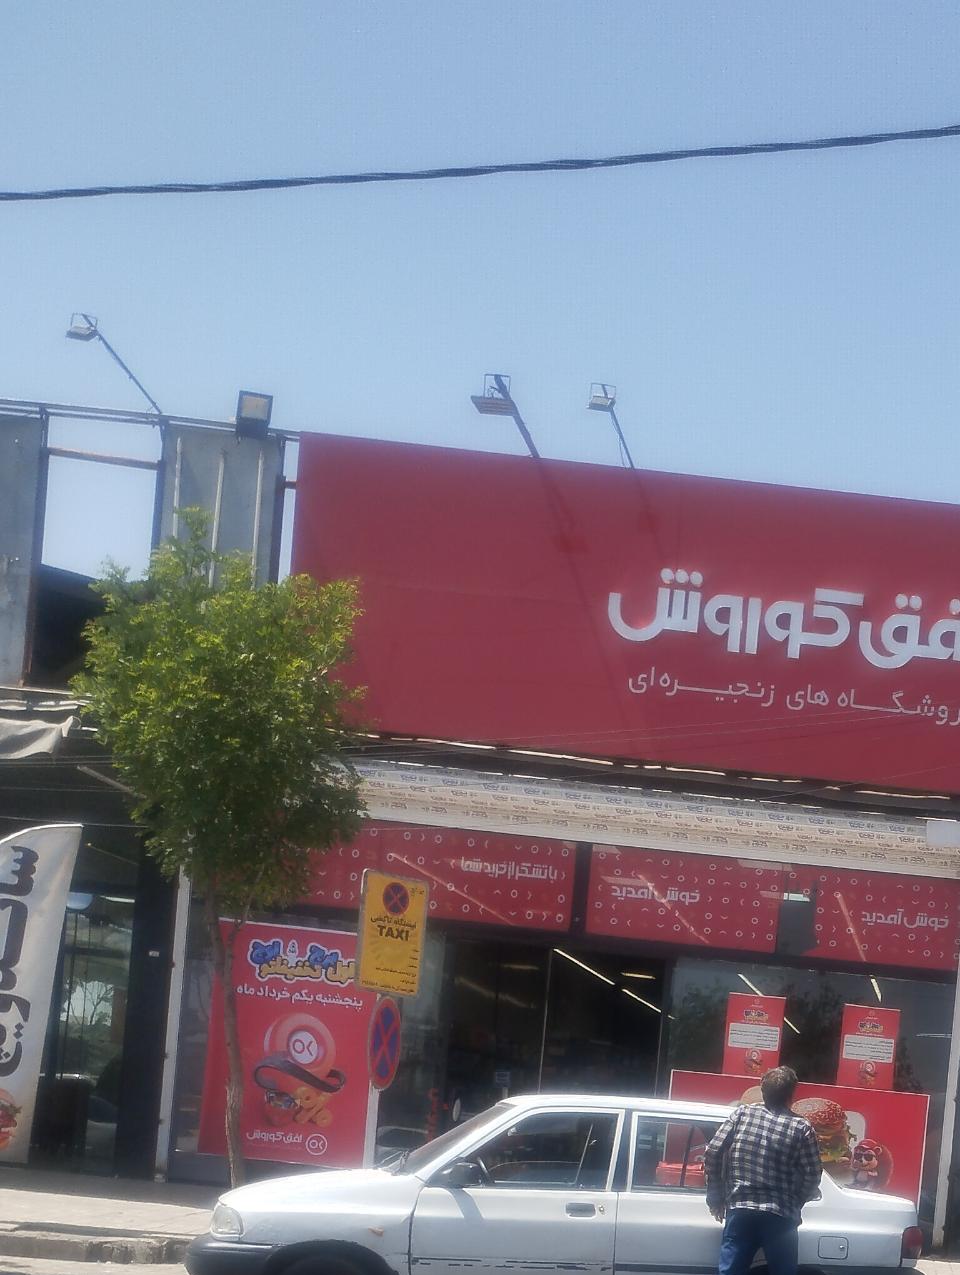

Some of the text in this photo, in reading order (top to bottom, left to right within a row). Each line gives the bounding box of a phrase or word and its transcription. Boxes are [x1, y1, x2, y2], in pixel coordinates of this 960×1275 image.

[608, 568, 865, 660] کوروش
[628, 666, 655, 694] ای
[660, 672, 776, 707] زنجیره
[786, 684, 830, 710] های
[377, 925, 410, 941] TAXI
[861, 908, 950, 931] خوش آمدید
[237, 983, 363, 1012] پنجشنبه یکم خرداد ماه
